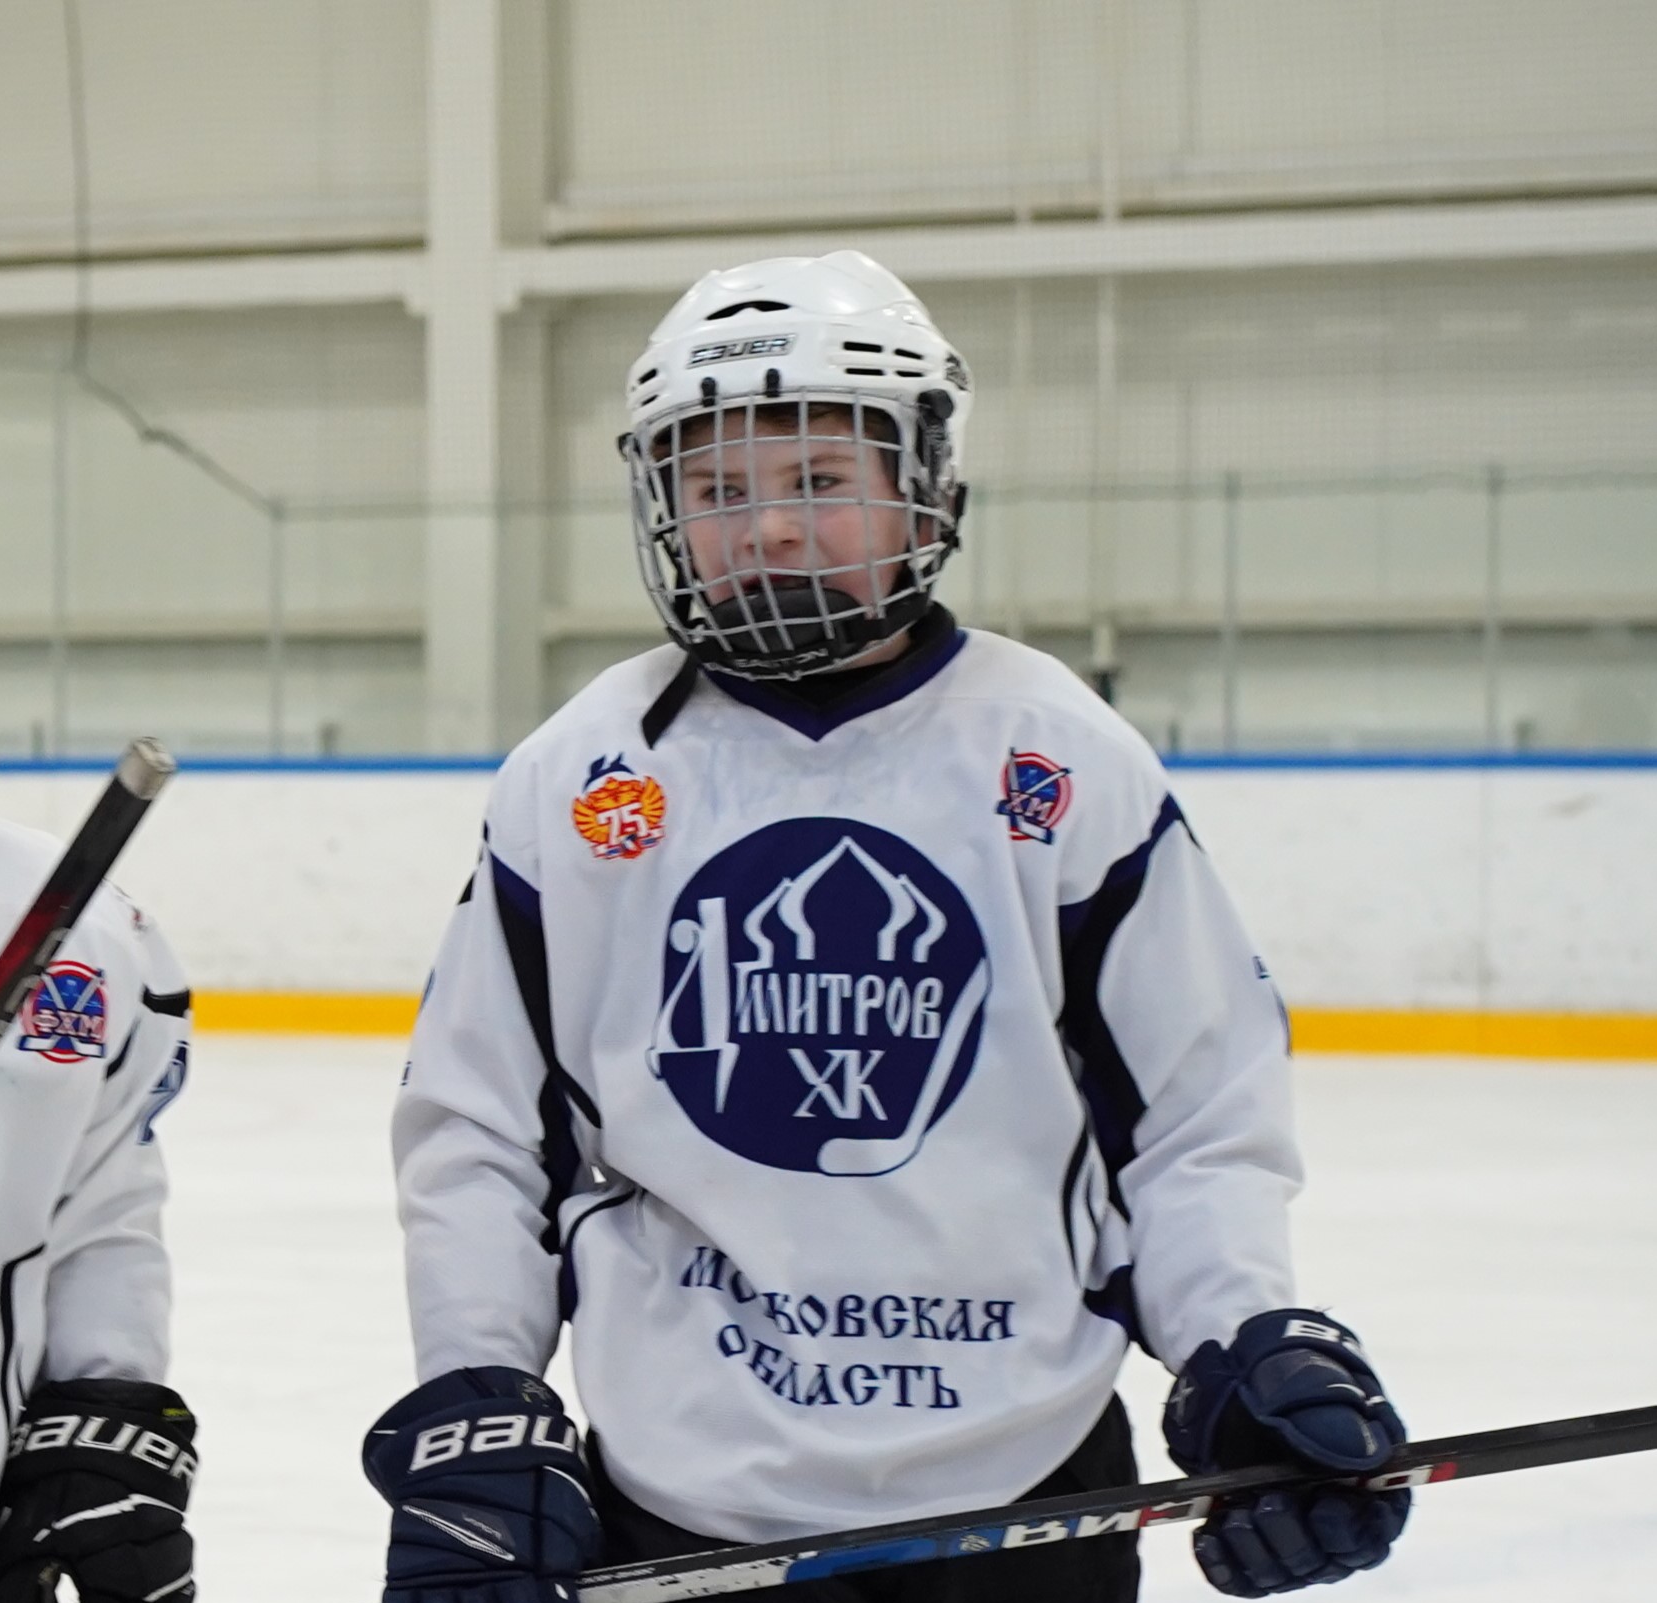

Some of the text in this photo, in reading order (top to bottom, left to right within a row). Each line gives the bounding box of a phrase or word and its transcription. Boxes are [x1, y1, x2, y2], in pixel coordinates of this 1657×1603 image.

[596, 801, 650, 844] 75
[31, 1008, 105, 1043] ФХМ
[789, 1049, 889, 1121] ХК
[716, 1323, 962, 1409] ОБЛАСТЬ
[409, 1414, 576, 1474] BAU
